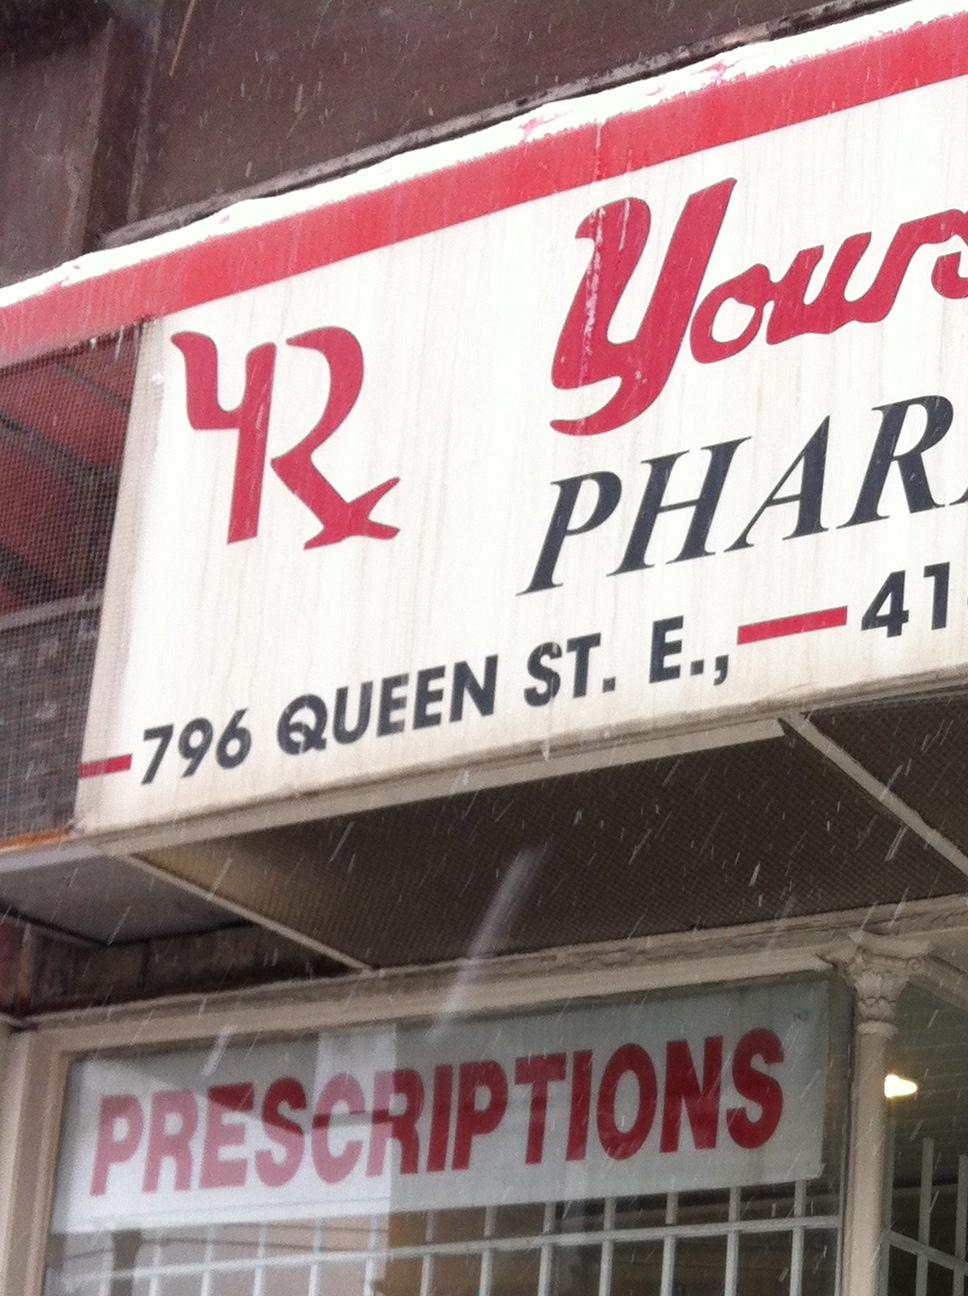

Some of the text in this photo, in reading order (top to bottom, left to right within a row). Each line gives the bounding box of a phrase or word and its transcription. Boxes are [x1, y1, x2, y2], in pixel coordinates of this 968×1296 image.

[142, 709, 252, 784] 796
[276, 655, 499, 753] QUEEN
[524, 634, 616, 707] ST.
[90, 1027, 786, 1197] PRESCRIPTIONS
